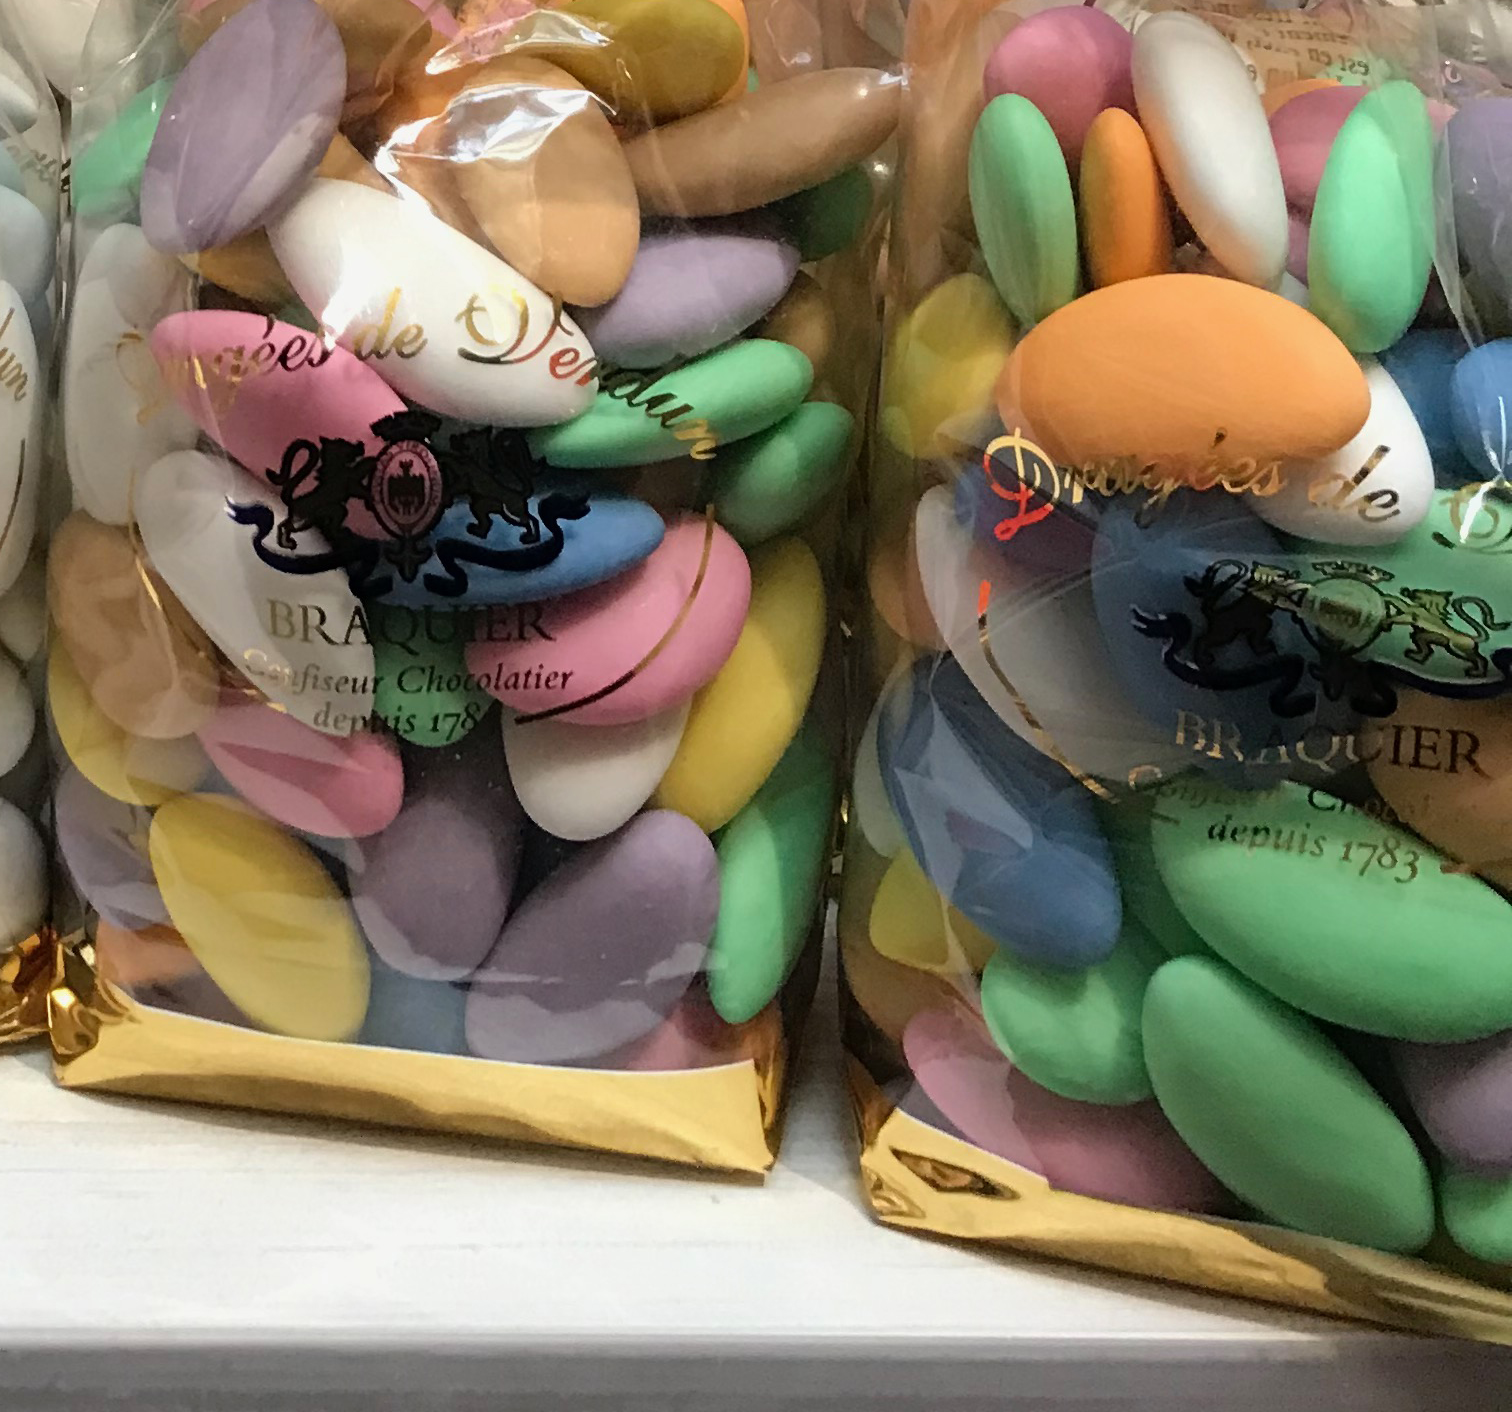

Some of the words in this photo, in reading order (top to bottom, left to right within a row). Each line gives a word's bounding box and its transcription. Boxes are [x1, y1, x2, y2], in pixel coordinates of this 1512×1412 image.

[354, 287, 428, 361] de
[456, 289, 719, 461] Verdun
[1307, 443, 1402, 524] de
[266, 598, 558, 655] BRAQUIER
[396, 661, 574, 696] Chocolatier
[430, 700, 484, 742] 178
[1175, 707, 1494, 781] BRAQUIER
[1206, 813, 1328, 859] depuis
[1341, 834, 1421, 885] 1783
